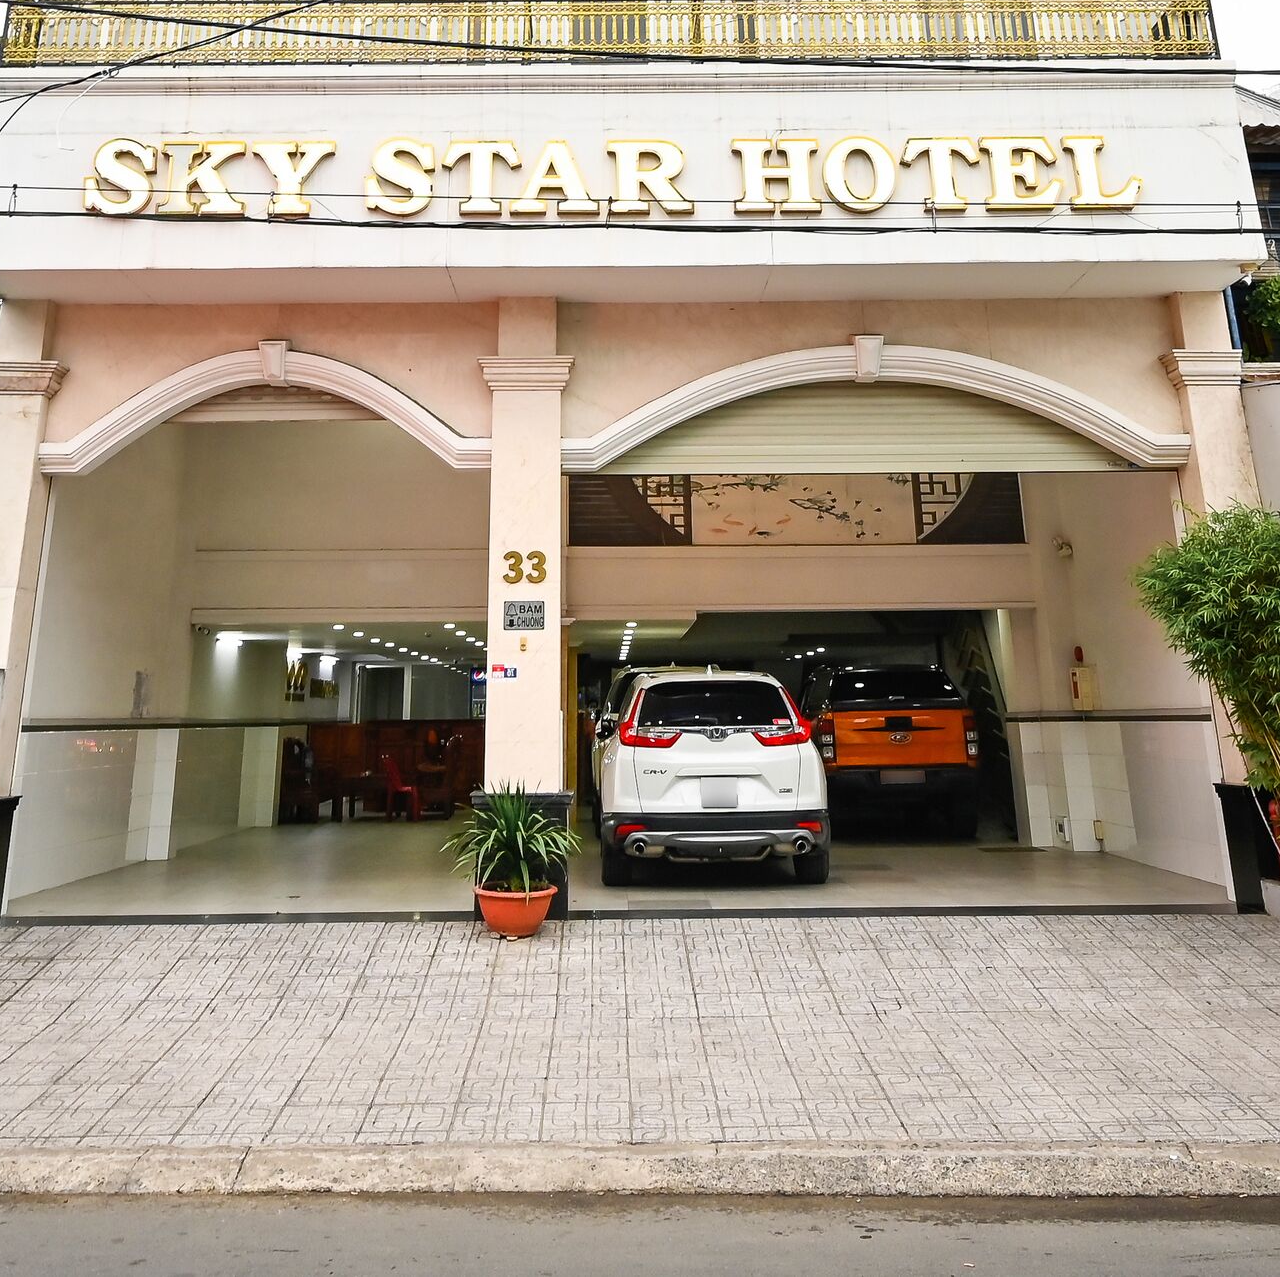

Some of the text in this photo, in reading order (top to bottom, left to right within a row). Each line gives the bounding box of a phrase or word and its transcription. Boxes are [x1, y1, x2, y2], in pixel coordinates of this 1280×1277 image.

[83, 135, 1143, 217] SKY STAR HOTEL
[502, 550, 547, 584] 33
